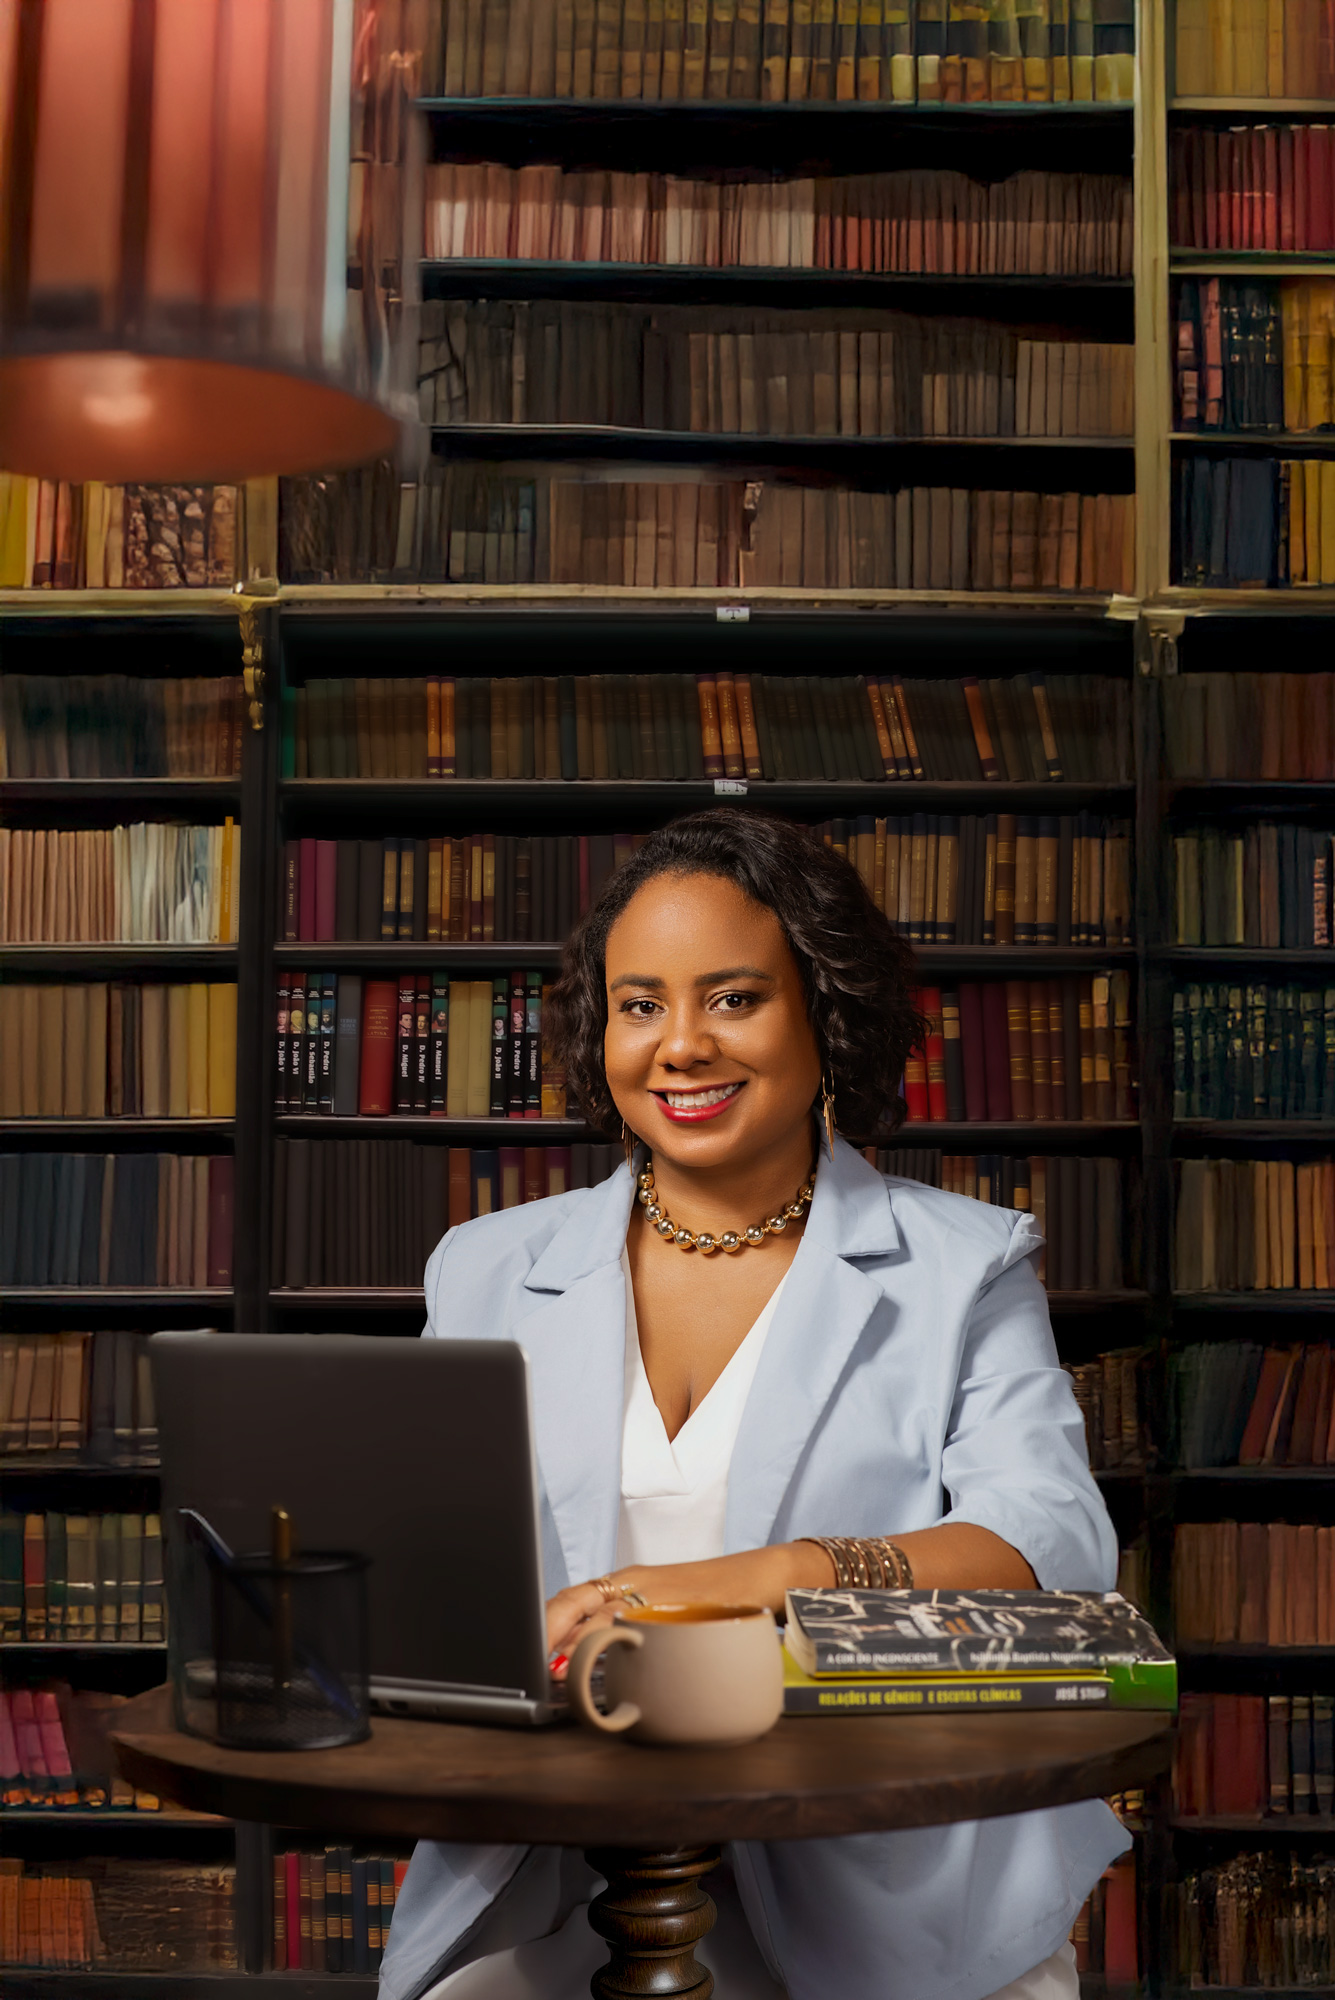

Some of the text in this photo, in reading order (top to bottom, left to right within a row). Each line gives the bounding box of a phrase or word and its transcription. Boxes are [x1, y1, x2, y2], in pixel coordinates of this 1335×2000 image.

[726, 608, 741, 620] T
[288, 882, 294, 890] DE
[278, 1041, 285, 1049] D.
[323, 1041, 330, 1049] D.
[435, 1040, 442, 1048] D.
[495, 1047, 502, 1055] D.
[514, 1040, 521, 1048] D.
[277, 1050, 286, 1066] João
[292, 1041, 300, 1075] D. João VI
[308, 1042, 316, 1084] D. Sebastião
[322, 1050, 330, 1071] Pedro
[401, 1044, 409, 1078] D. Miguel
[418, 1044, 426, 1084] D. Pedro IV
[494, 1056, 502, 1072] João
[513, 1050, 521, 1070] Pedro
[529, 1040, 537, 1081] D. Henrique
[826, 1651, 940, 1664] A COR DO INCONSCIENTE
[1012, 1651, 1050, 1664] Baptista
[818, 1687, 1022, 1707] RELAÇÕES DE GÊNERO E ESCUTAS CLÍNICAS
[1055, 1685, 1078, 1701] JOSÉ
